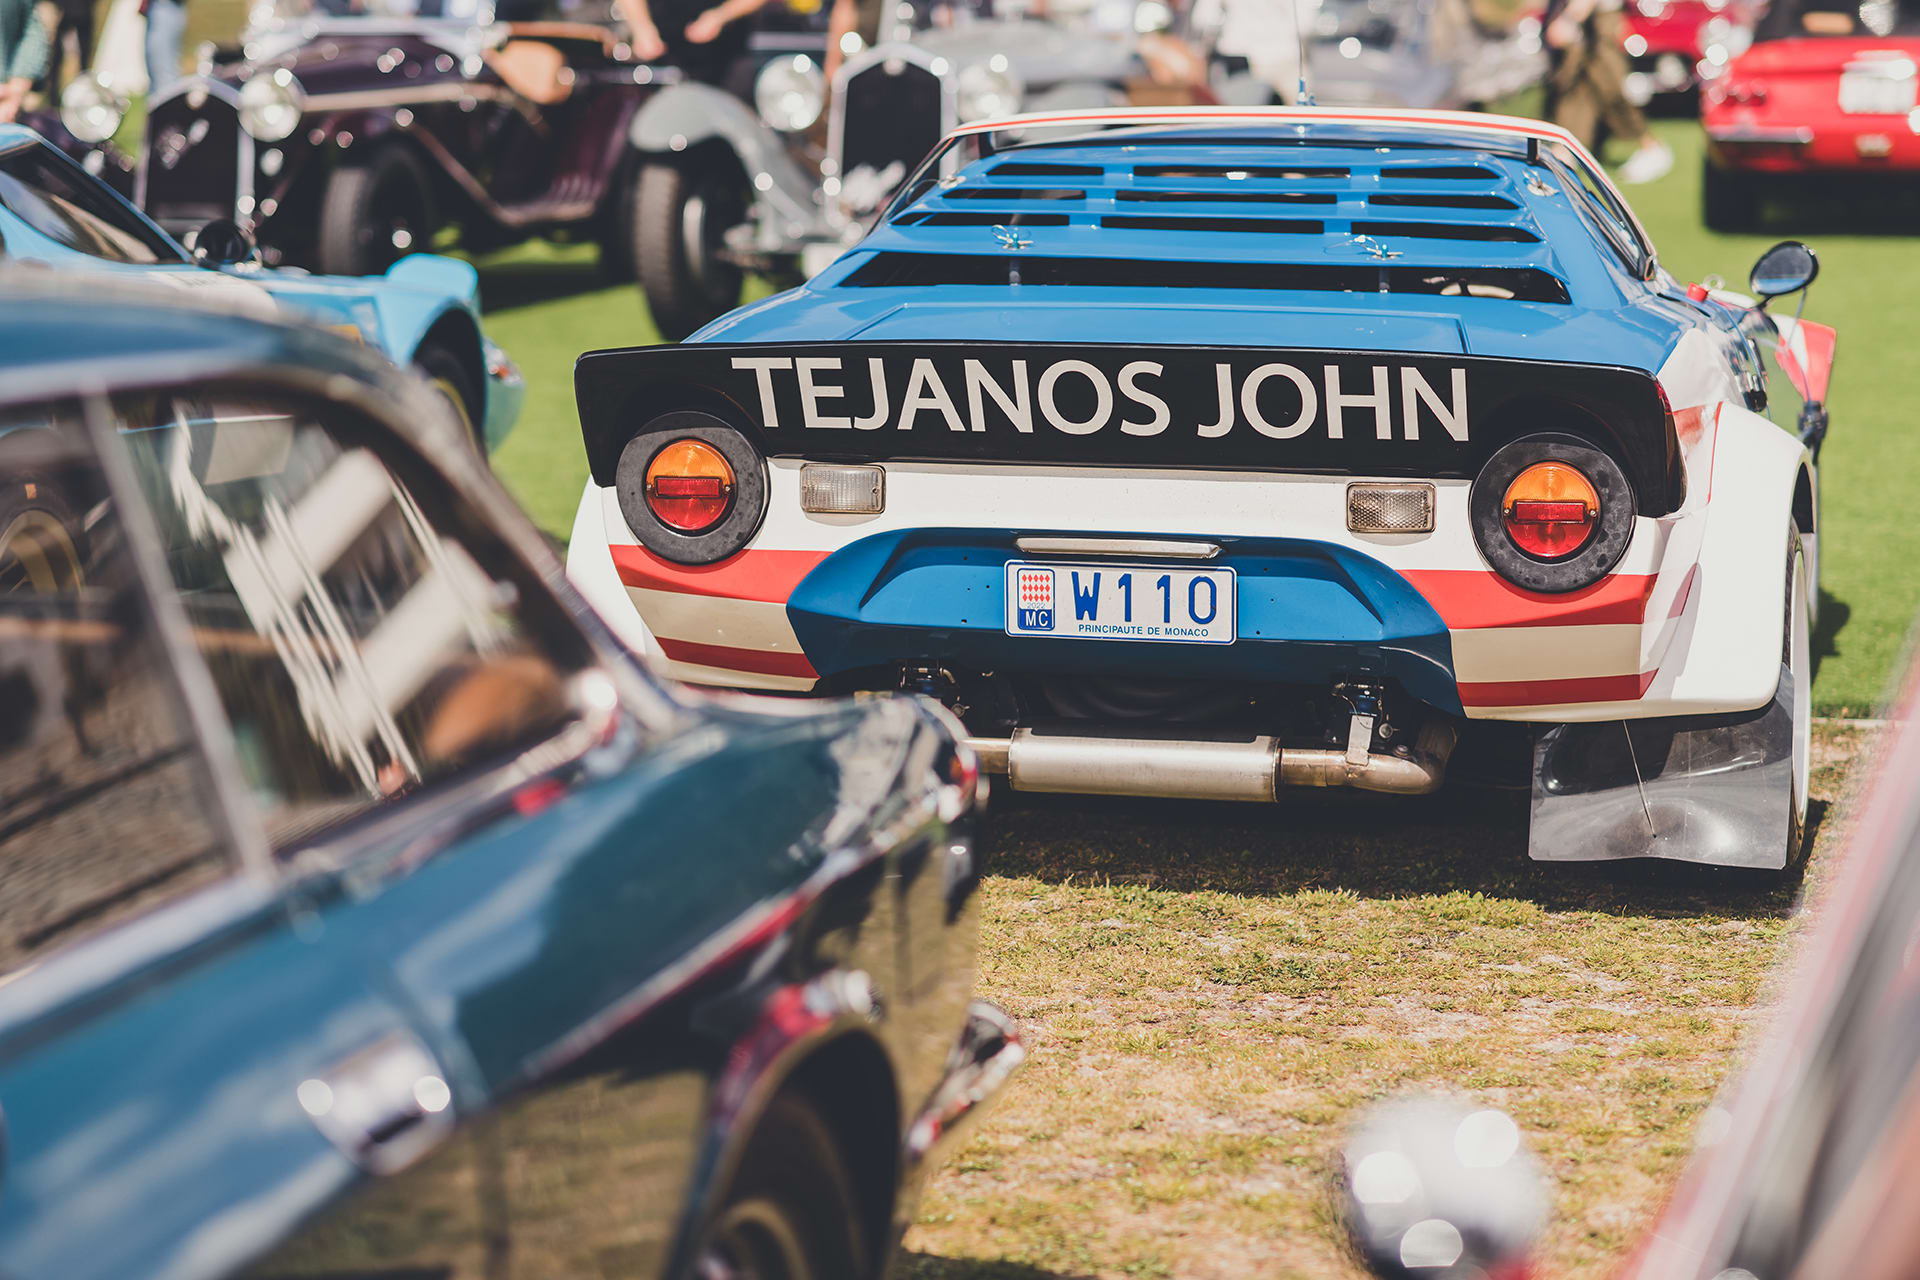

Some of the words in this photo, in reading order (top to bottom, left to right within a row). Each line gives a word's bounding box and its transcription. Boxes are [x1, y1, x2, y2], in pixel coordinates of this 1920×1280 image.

[731, 356, 1171, 438] TEJANOS
[1197, 363, 1469, 443] JOHN
[1071, 571, 1217, 625] W110
[1025, 611, 1048, 627] MC
[1078, 624, 1143, 635] PRINCIPAUTE
[1147, 626, 1160, 635] DE
[1164, 627, 1209, 637] MONACO
